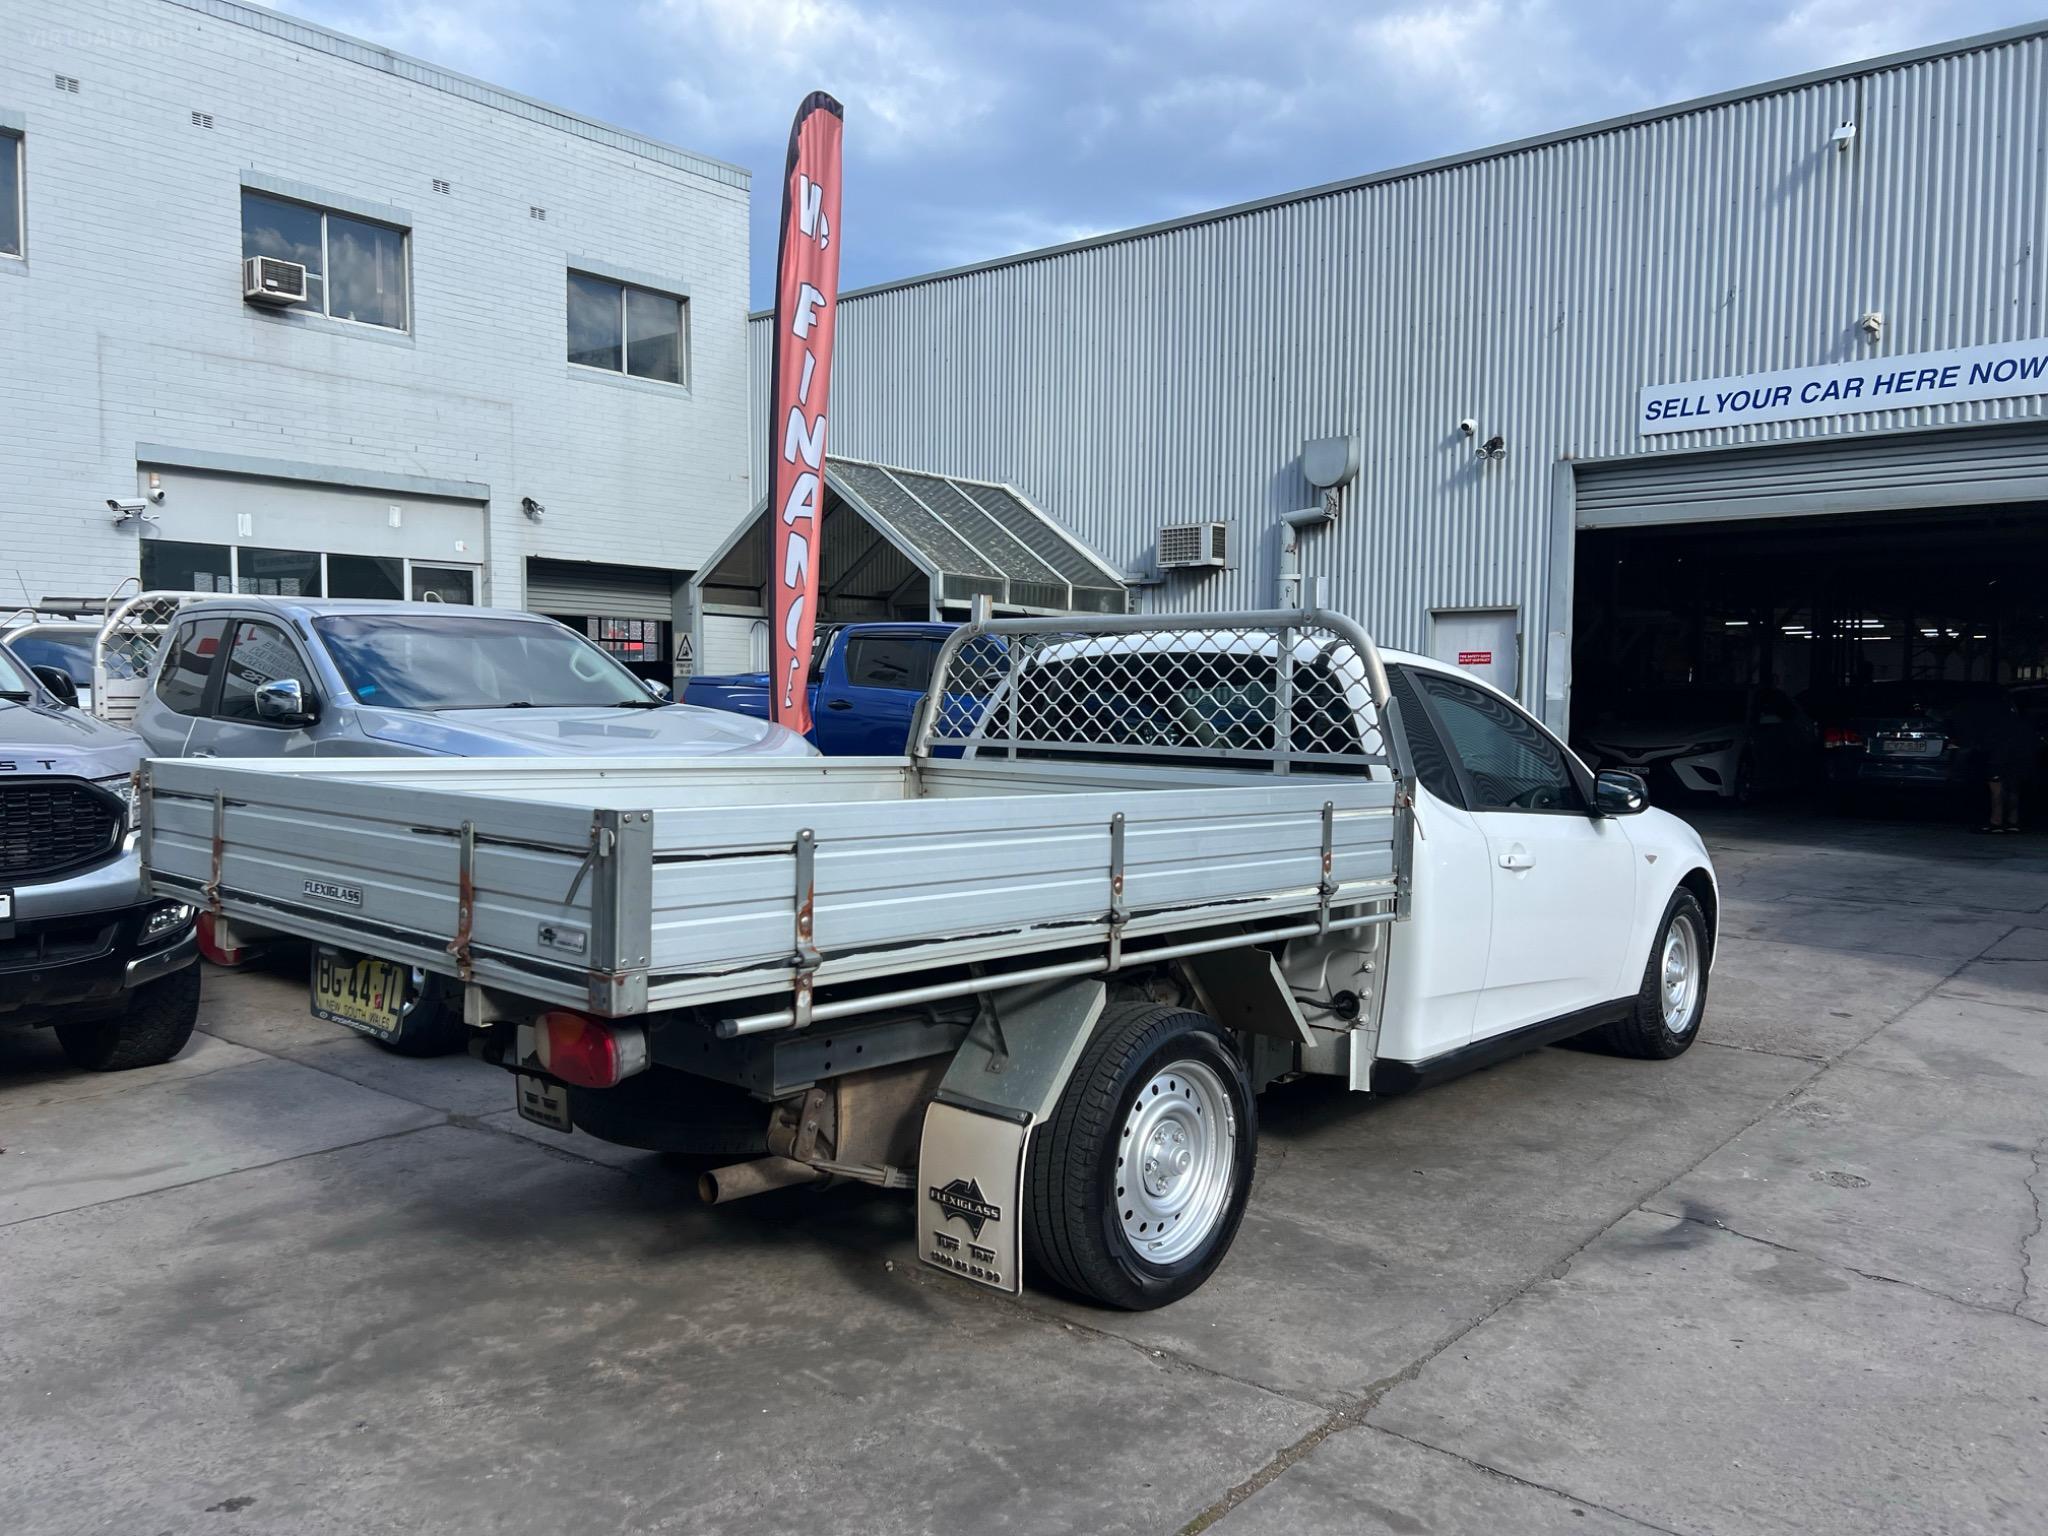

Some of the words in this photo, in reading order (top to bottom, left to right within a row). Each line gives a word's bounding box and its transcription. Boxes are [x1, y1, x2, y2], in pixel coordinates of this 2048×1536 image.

[1645, 396, 1711, 421] SELL
[1715, 385, 1792, 413] YOUR
[1800, 376, 1865, 404] CAR
[1872, 365, 1961, 396] HERE
[1968, 356, 2048, 385] NOW
[304, 881, 360, 902] FLEXIGLASS
[326, 999, 340, 1012] NEW
[343, 1004, 367, 1019] SOUTH
[369, 1012, 390, 1030] WALES
[930, 1189, 999, 1218] FLEXIGLASS
